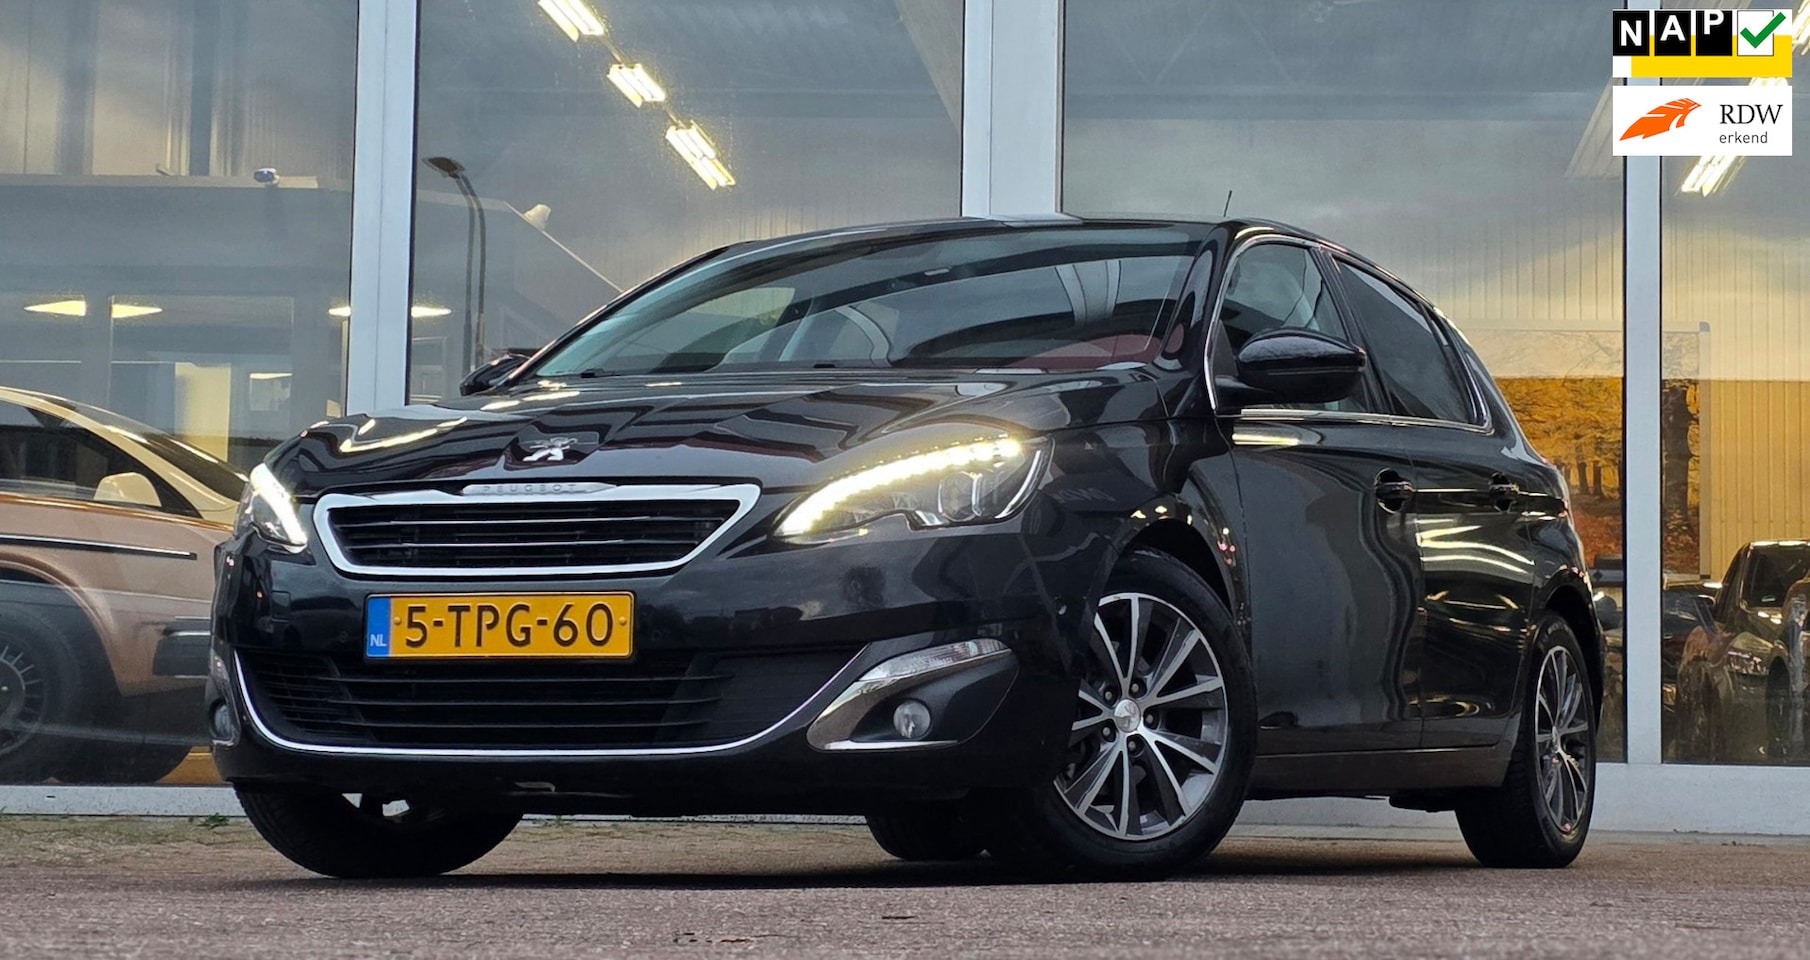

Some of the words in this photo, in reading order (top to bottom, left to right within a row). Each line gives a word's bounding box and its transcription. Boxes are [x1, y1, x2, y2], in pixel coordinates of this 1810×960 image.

[482, 484, 577, 494] PEUGEOT
[405, 602, 614, 648] 5-TPG-60
[369, 634, 387, 647] NL
